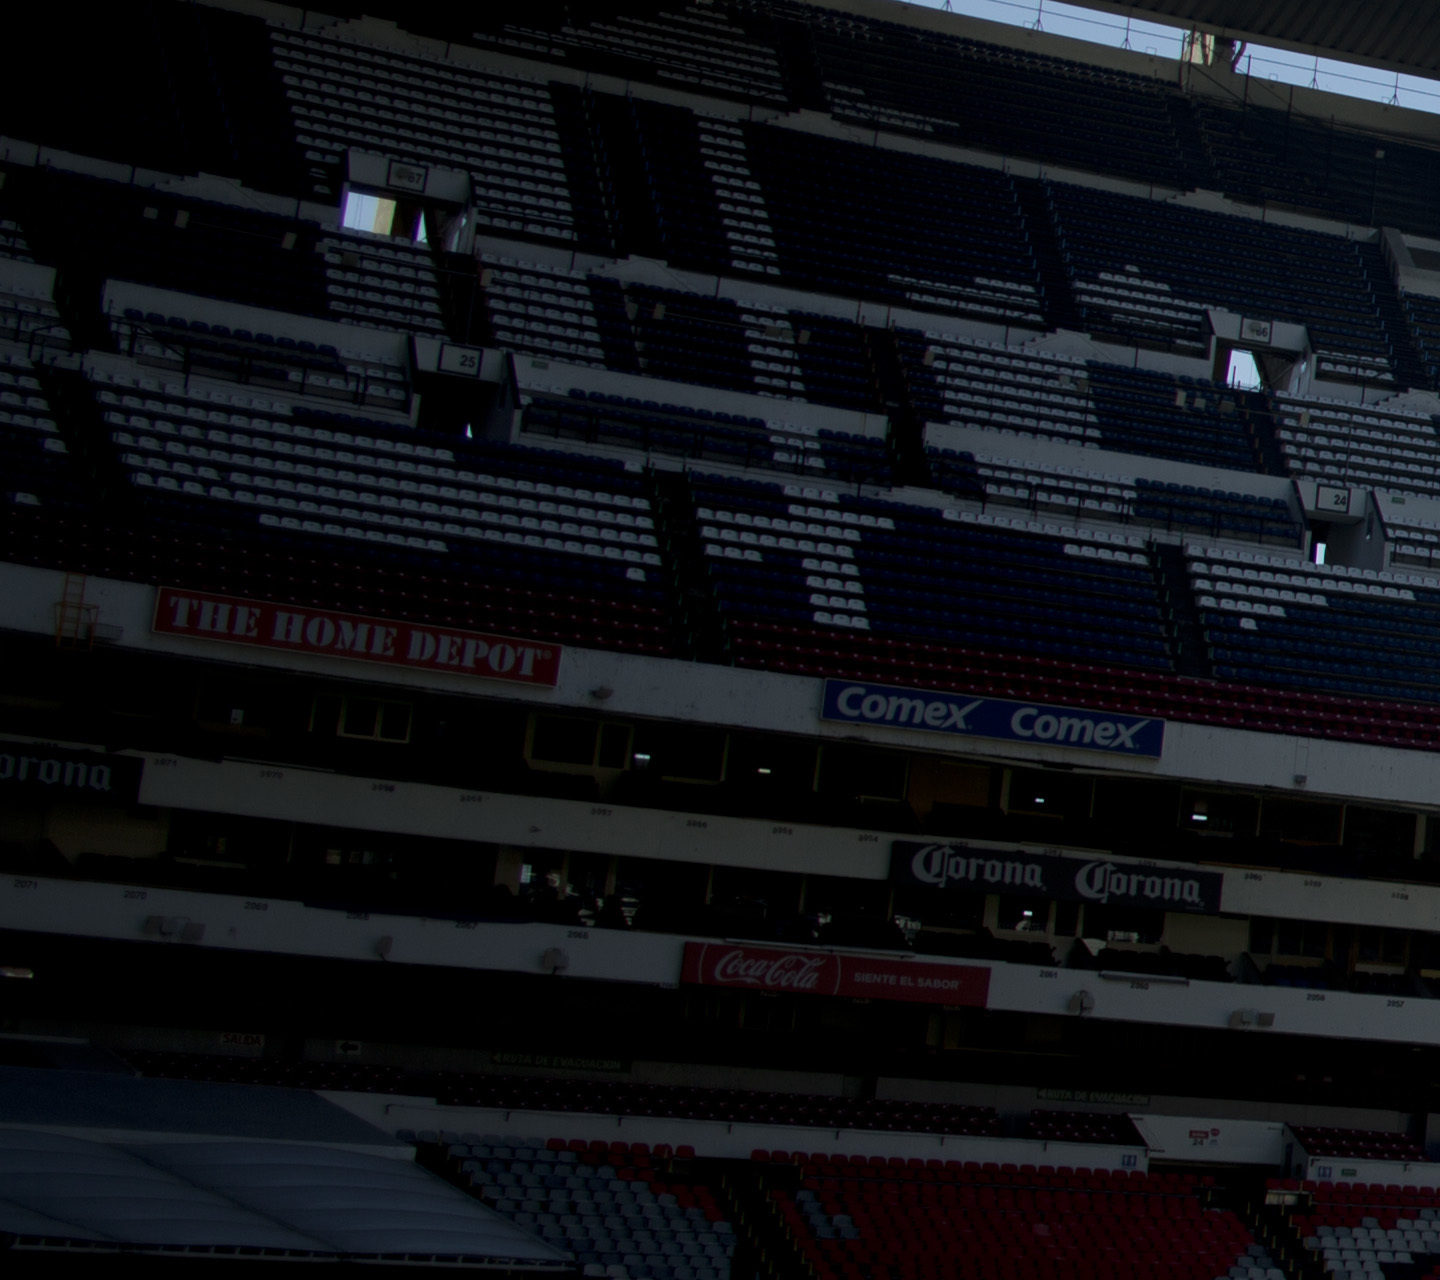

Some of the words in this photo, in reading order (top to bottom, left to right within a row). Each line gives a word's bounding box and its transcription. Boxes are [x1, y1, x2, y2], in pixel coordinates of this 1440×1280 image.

[460, 355, 476, 368] 25
[1334, 494, 1347, 506] 24
[169, 596, 261, 638] THE
[271, 610, 397, 658] HOME
[407, 629, 542, 677] DEPOT
[837, 686, 985, 730] Comex
[1010, 707, 1150, 750] Comex
[0, 752, 113, 792] orona
[13, 878, 39, 891] 2071
[123, 889, 148, 900] 2070
[911, 845, 1043, 888] Corona
[1075, 861, 1203, 904] Corona
[714, 950, 826, 990] Coca-Cola
[853, 971, 897, 985] SIENTE
[899, 974, 915, 986] EL
[916, 975, 959, 990] SABOR
